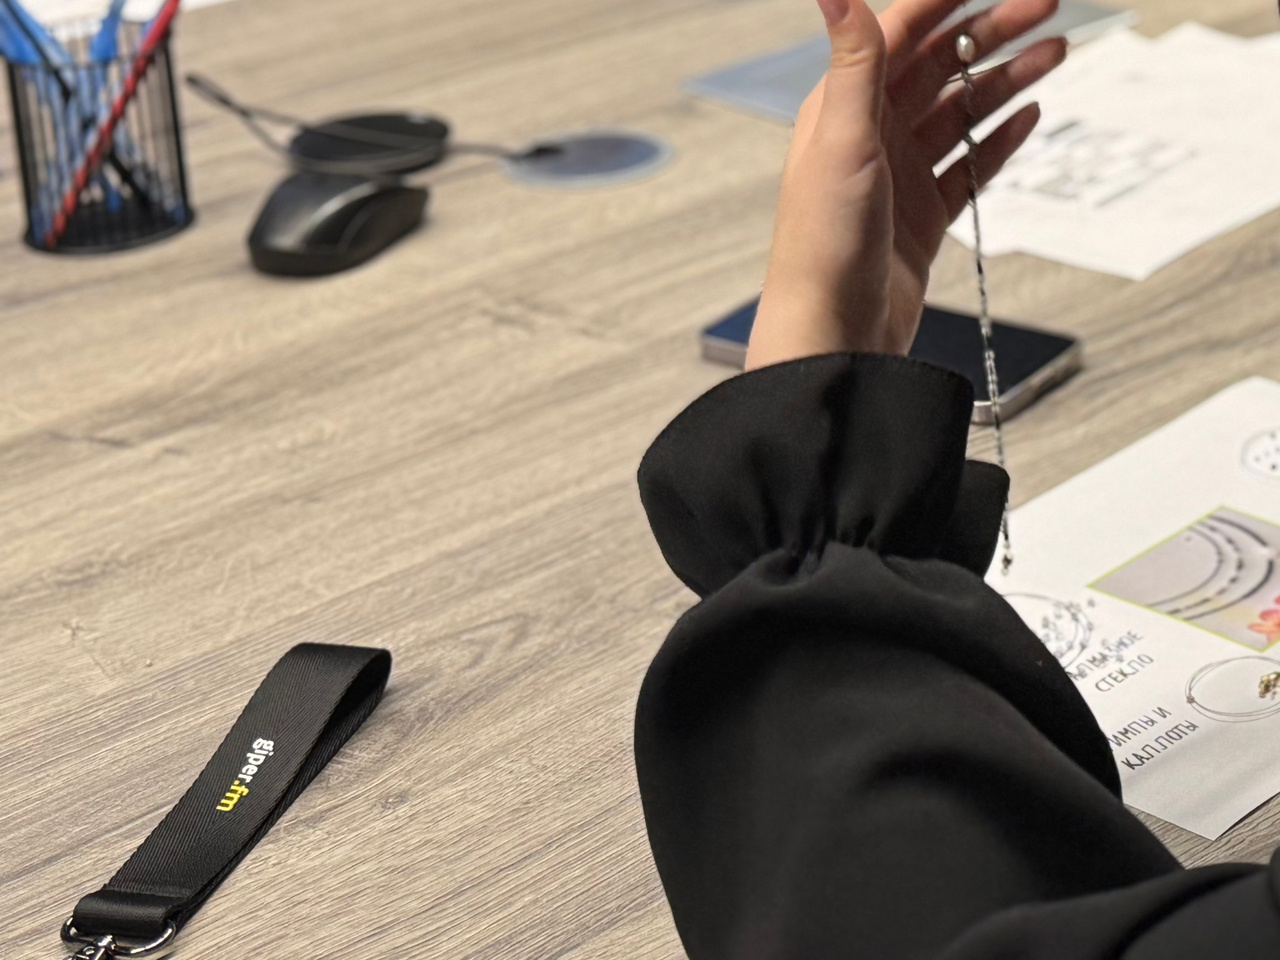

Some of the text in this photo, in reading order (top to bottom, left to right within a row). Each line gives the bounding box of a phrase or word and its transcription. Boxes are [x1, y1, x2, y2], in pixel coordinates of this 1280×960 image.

[1095, 653, 1154, 692] СТЕКЛО
[1108, 706, 1172, 751] ИМПЫ И
[1120, 719, 1200, 770] КАЛЛОТЫ
[216, 737, 275, 812] giper.fm
